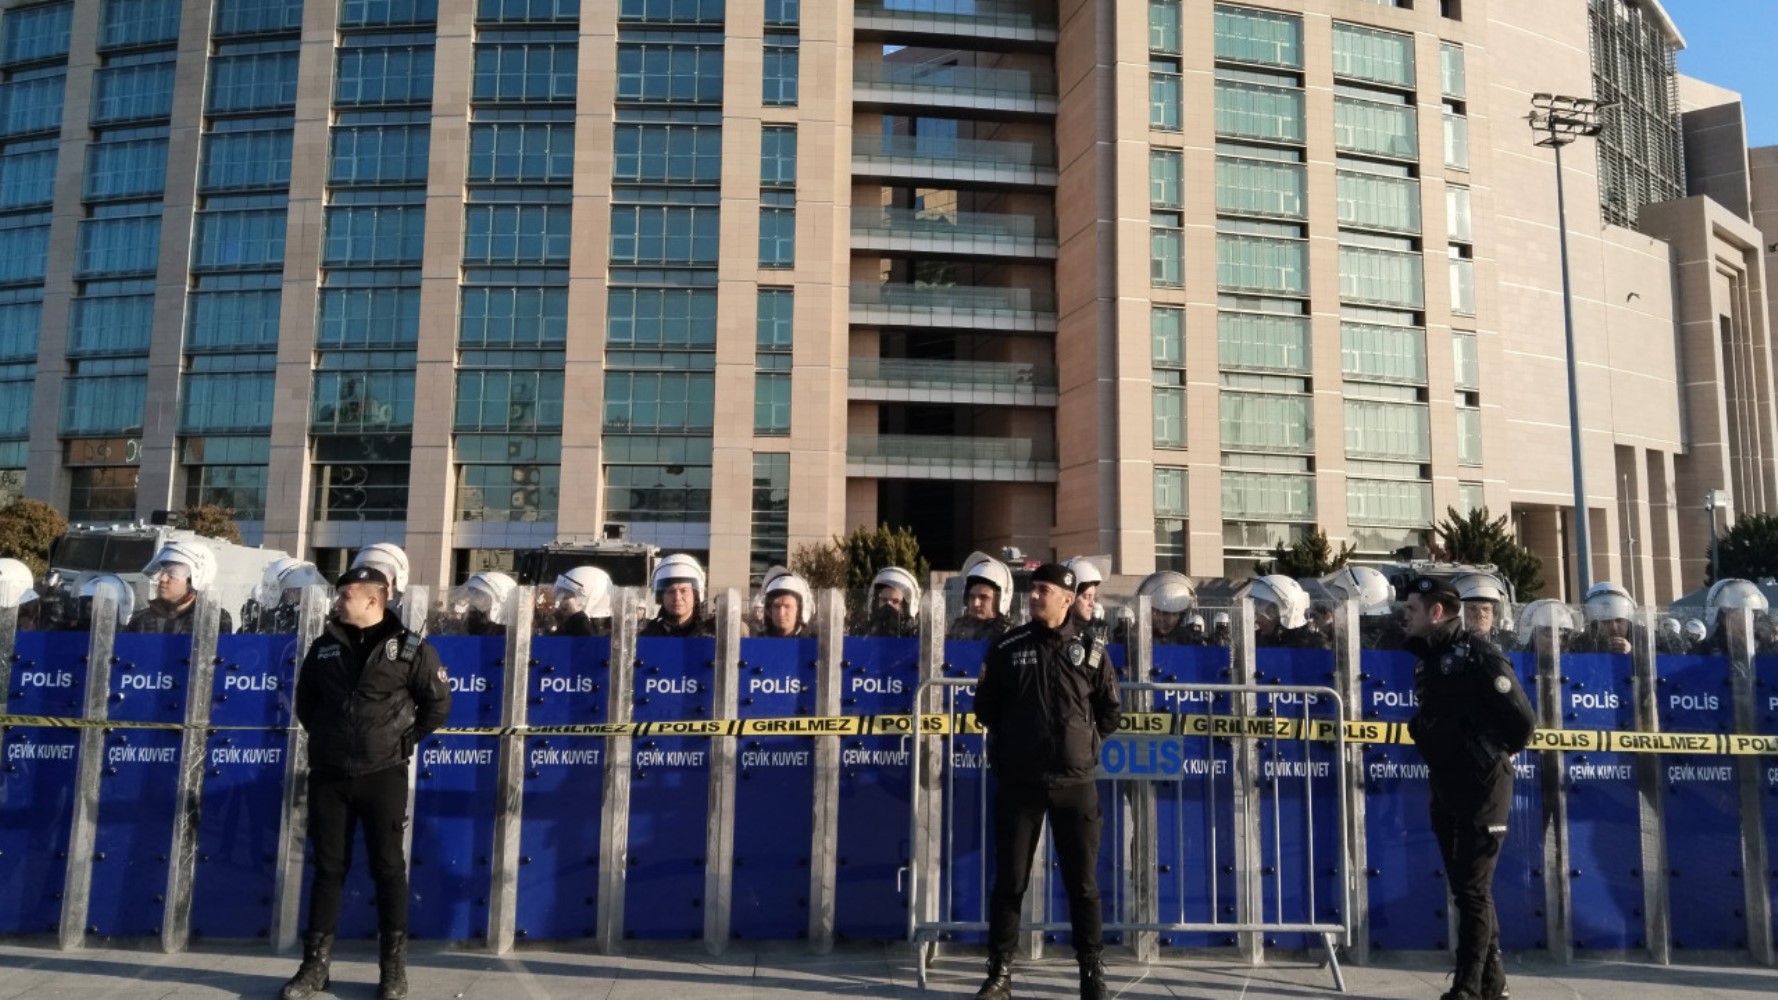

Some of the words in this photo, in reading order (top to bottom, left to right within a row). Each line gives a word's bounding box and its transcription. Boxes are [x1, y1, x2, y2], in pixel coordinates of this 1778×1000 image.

[21, 670, 71, 687] POLİS
[121, 672, 172, 689] POLİS
[225, 673, 277, 690] POLİS
[448, 675, 485, 692] OLİS
[541, 675, 591, 692] POLİS
[646, 676, 697, 693] POLİS
[751, 676, 800, 693] POLİS
[852, 677, 901, 693] POLİS
[1268, 692, 1318, 705] POLS
[1572, 692, 1618, 708] POLİS
[1671, 693, 1718, 709] POLİS
[657, 721, 720, 733] POLİS
[752, 718, 852, 732] GİRİLMEZ
[881, 716, 943, 731] POİS
[1119, 716, 1163, 731] OLİS
[1193, 718, 1290, 735] GRİLMEZ
[8, 741, 35, 761] ÇEVİK
[38, 745, 74, 759] KUVVET
[1533, 732, 1590, 747] POLİS
[1619, 734, 1711, 750] GİRİLMEZ
[1737, 738, 1778, 752] POL
[109, 744, 136, 764] ÇEVİK
[138, 748, 175, 761] KUVVET
[212, 746, 240, 766] ÇEVİK
[243, 749, 280, 763] KUVVET
[423, 747, 451, 767] ÇEVİK
[454, 750, 492, 764] KUVVET
[531, 747, 559, 767] ÇEVİK
[561, 750, 599, 764] KUVVET
[637, 749, 664, 769] ÇEVİK
[667, 752, 703, 765] KUVVET
[742, 749, 769, 769] ÇEVİK
[772, 752, 808, 766] KUVVET
[843, 747, 870, 766] ÇEVİK
[1100, 739, 1182, 775] OLİS
[1370, 760, 1398, 780] ÇEVİK
[1569, 763, 1595, 780] ÇEVİK
[1597, 765, 1630, 779] KUVVET
[1669, 764, 1695, 783] ÇEVİK
[1697, 767, 1731, 780] KUVVET
